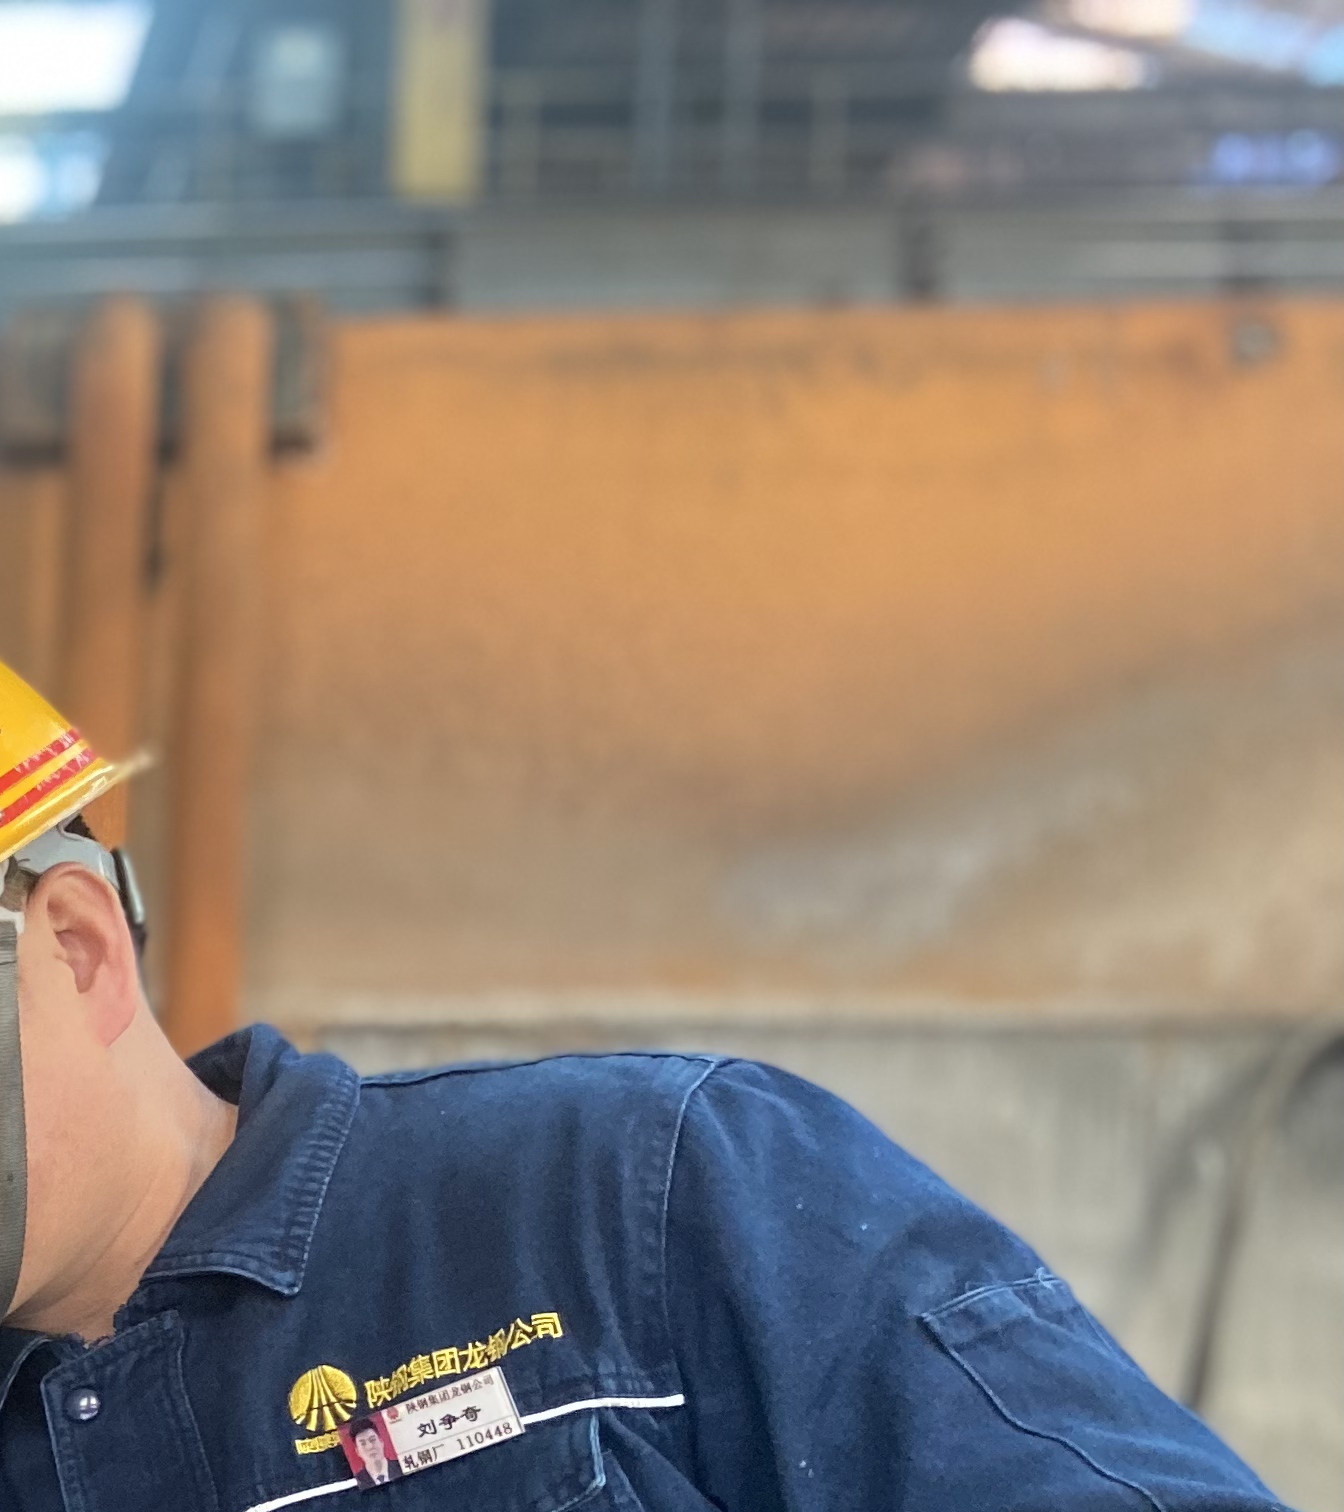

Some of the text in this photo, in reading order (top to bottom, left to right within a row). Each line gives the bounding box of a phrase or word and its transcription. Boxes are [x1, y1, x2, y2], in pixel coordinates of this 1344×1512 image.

[364, 1312, 563, 1408] 陕钢集团龙钢公司
[405, 1374, 495, 1415] 陕钢集团龙钢公司
[404, 1421, 513, 1470] 轧钢厂 110448
